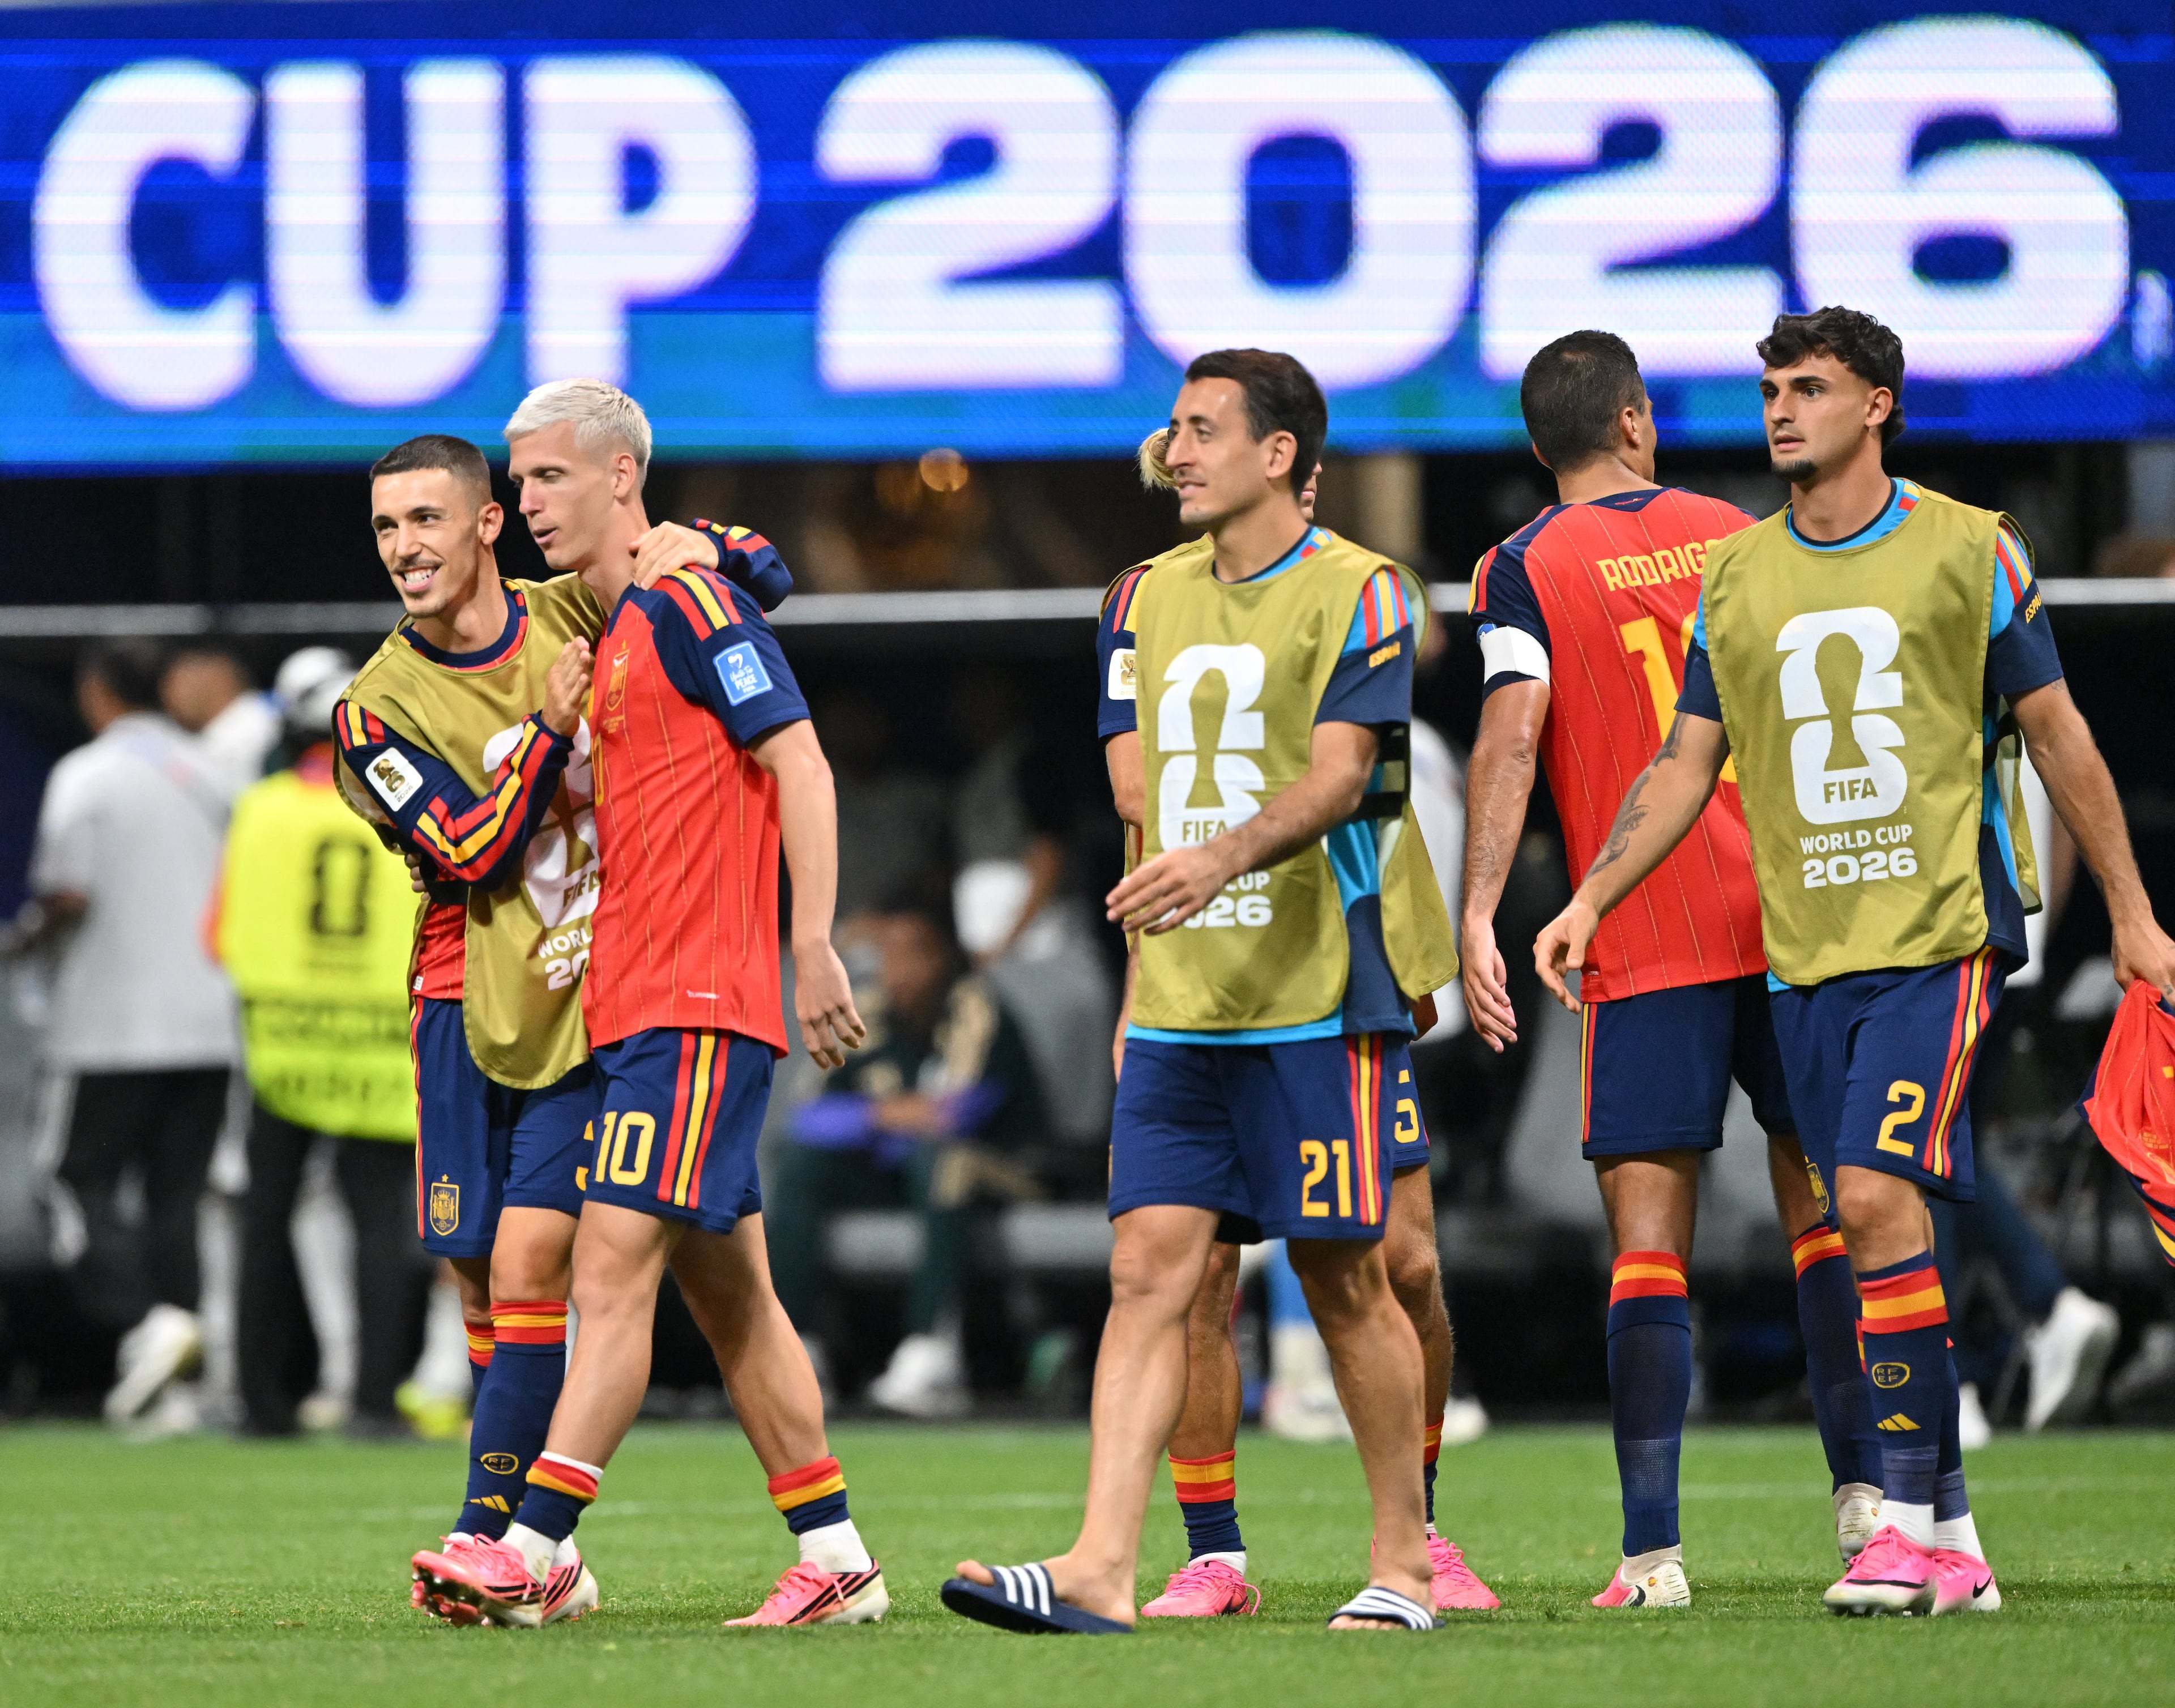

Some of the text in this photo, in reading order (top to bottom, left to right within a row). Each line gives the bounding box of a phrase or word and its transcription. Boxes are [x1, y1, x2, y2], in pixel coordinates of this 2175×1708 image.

[32, 15, 2130, 412] CUP 2026
[1823, 777, 1879, 804] FIFA
[1799, 824, 1913, 855] WORLD CUP
[1802, 847, 1918, 889] 2026
[595, 1111, 656, 1186] 10
[1876, 1080, 1926, 1158] 2
[1299, 1139, 1352, 1218] 21
